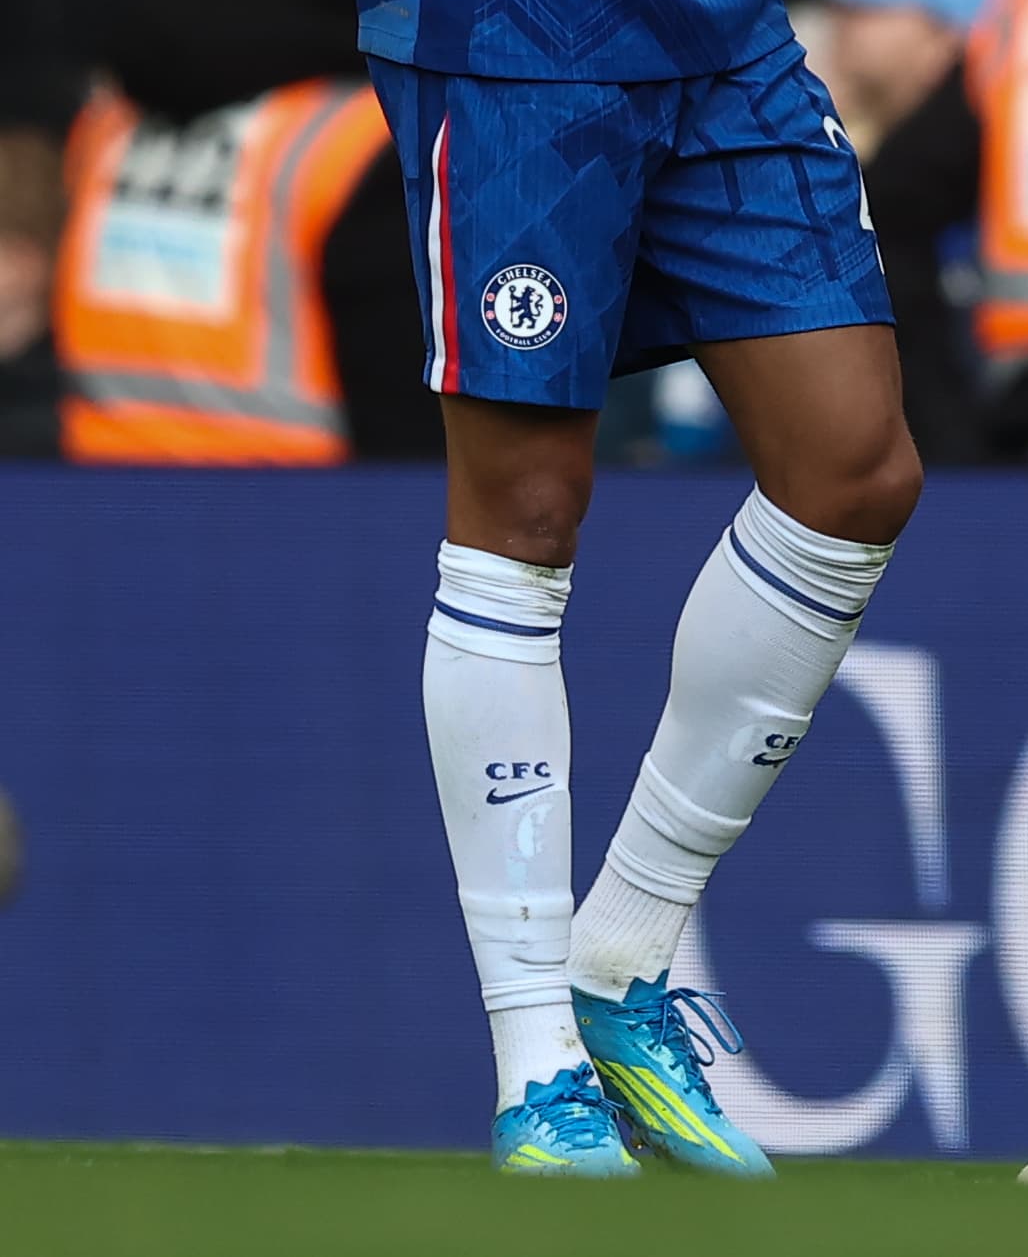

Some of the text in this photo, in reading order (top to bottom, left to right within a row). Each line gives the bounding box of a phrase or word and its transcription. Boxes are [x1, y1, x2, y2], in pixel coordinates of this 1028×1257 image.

[497, 268, 552, 287] CHELSEA
[495, 328, 552, 346] FOOTBALL CLUB
[765, 733, 801, 750] CF
[485, 761, 552, 781] CFC
